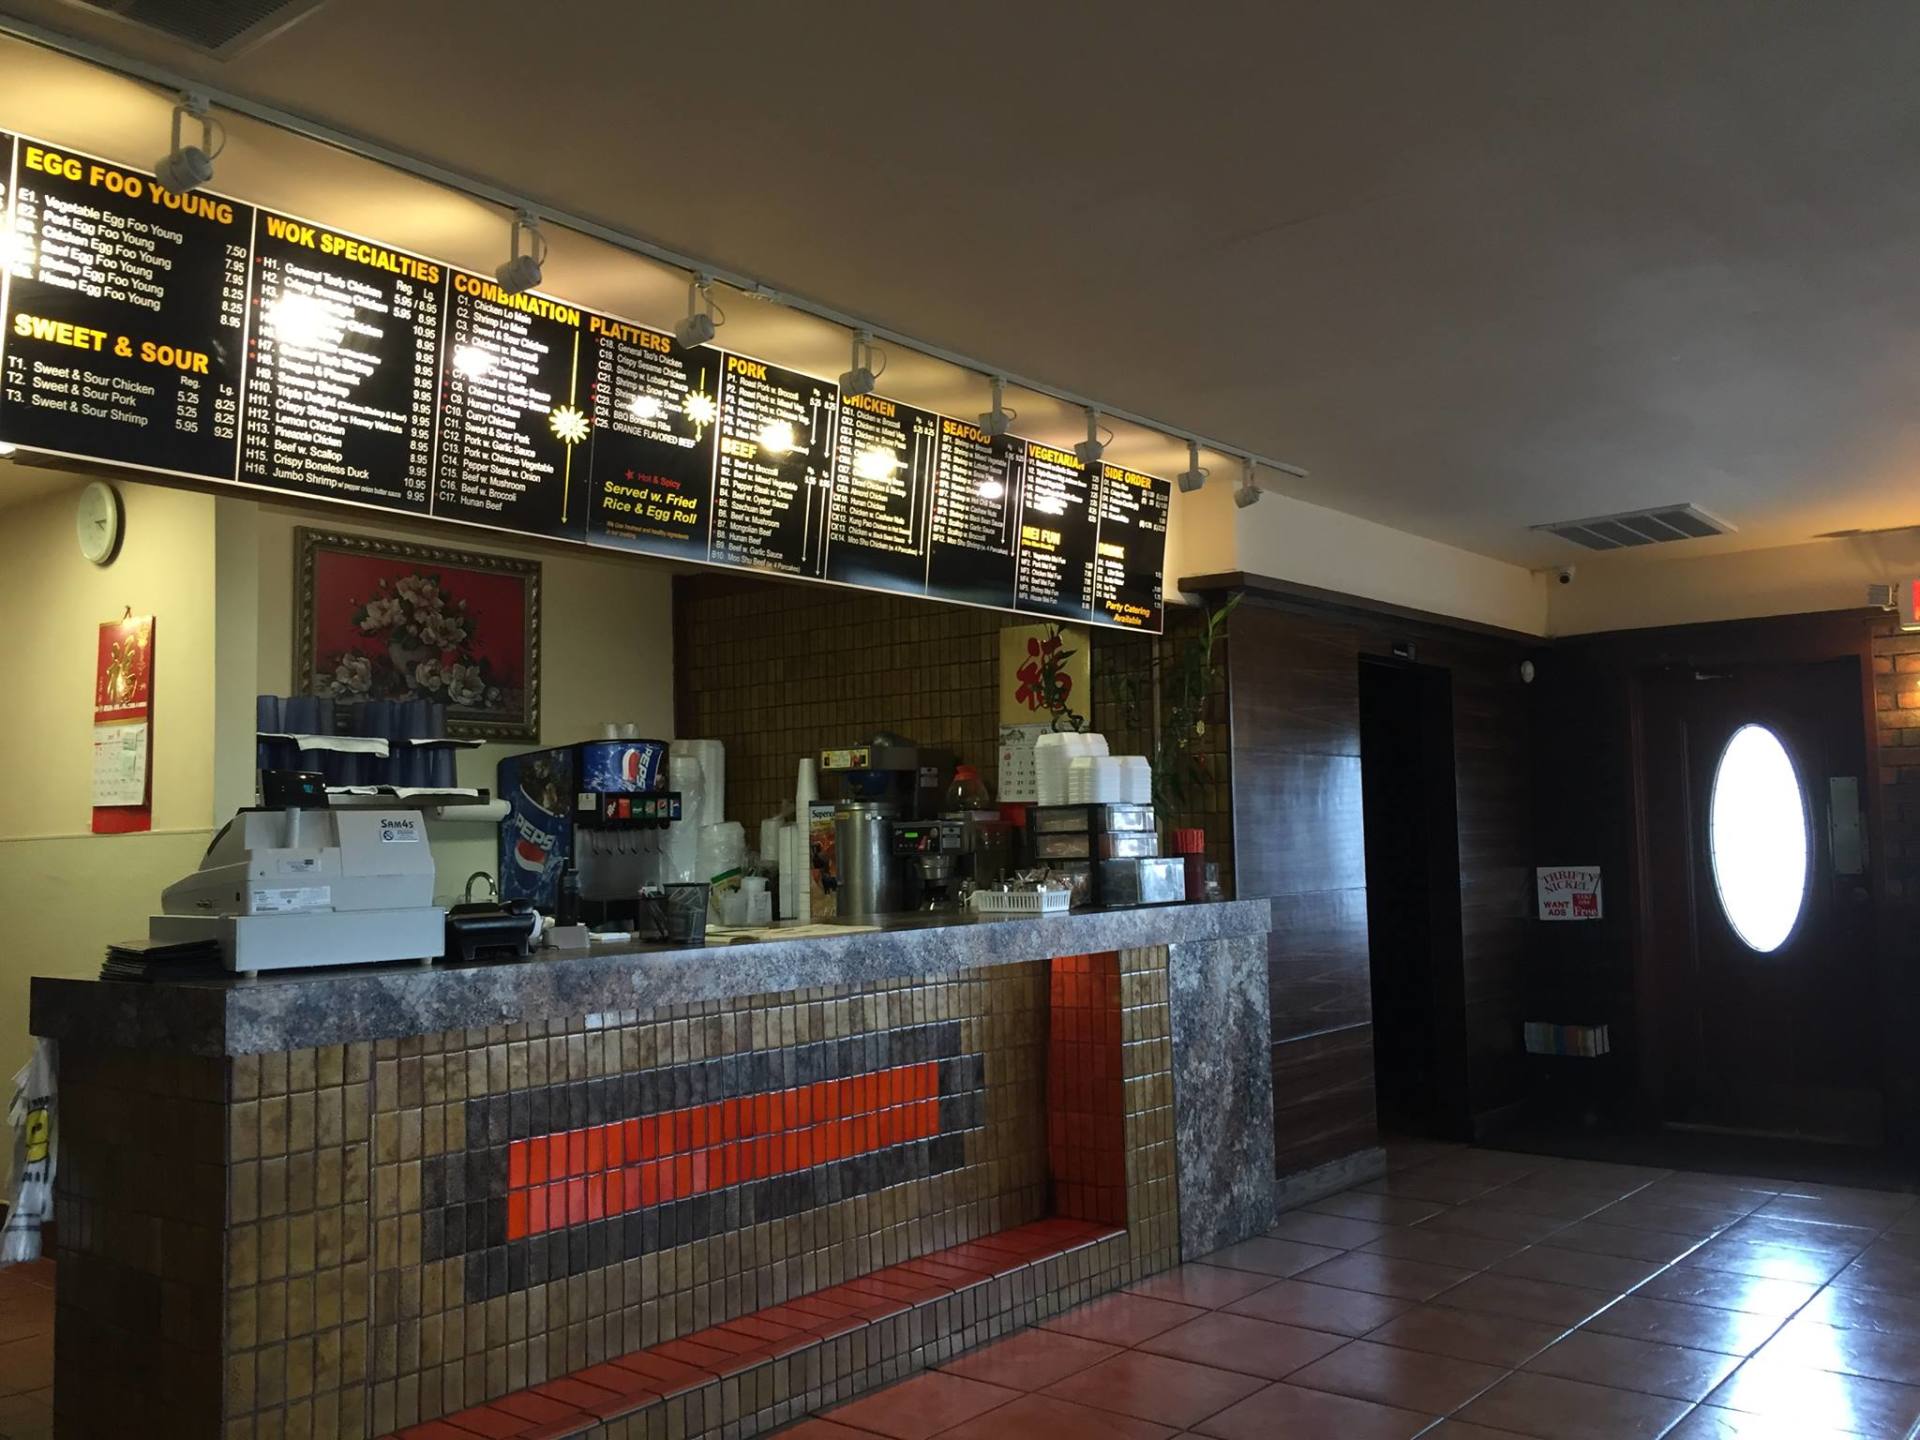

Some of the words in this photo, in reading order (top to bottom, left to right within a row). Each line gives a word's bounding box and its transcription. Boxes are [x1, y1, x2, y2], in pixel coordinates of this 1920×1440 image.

[26, 147, 82, 180] EGG
[90, 166, 142, 198] FOO
[150, 183, 234, 224] YOUNG
[19, 188, 39, 203] E1.
[45, 195, 100, 219] Vegetable
[103, 212, 125, 228] Egg
[127, 219, 148, 233] Foo
[151, 224, 183, 244] Young
[226, 245, 247, 258] 7.50
[43, 210, 71, 227] Pork
[73, 218, 95, 235] Egg
[98, 225, 119, 239] Foo
[122, 231, 155, 250] Young
[225, 259, 244, 272] 7.95
[267, 216, 316, 248] WOK
[320, 234, 440, 284] SPECIALTIES
[42, 226, 88, 246] Chicken
[91, 238, 113, 255] Egg
[116, 244, 136, 259] Foo
[139, 250, 171, 270] Young
[225, 272, 243, 285] 7.95
[70, 248, 93, 265] Egg
[96, 255, 117, 269] Foo
[120, 260, 153, 279] Young
[223, 287, 244, 300] 8.25
[263, 257, 280, 271] H1.
[394, 295, 412, 307] 5.95
[419, 300, 437, 314] 8.95
[83, 267, 105, 283] Egg
[107, 273, 129, 287] Foo
[132, 278, 164, 298] Young
[222, 301, 243, 314] 8.25
[454, 274, 580, 327] COMBINATION
[79, 281, 101, 297] Egg
[104, 286, 125, 300] Foo
[128, 293, 160, 311] Young
[220, 315, 240, 328] 8.95
[393, 308, 411, 319] 5.95
[418, 313, 436, 326] 8.95
[458, 295, 470, 306] C1.
[474, 300, 503, 316] Chicken
[504, 309, 513, 319] Lo
[413, 325, 435, 338] 10.95
[473, 312, 498, 328] Shrimp
[500, 320, 509, 330] Lo
[14, 314, 107, 351] SWEET
[114, 336, 133, 357] &
[141, 342, 209, 374] SOUR
[416, 339, 435, 351] 8.95
[590, 316, 671, 353] PLATTERS
[415, 352, 434, 364] 9.95
[728, 356, 767, 380] PORK
[8, 356, 26, 370] T1.
[34, 361, 69, 379] Sweet
[72, 369, 80, 380] &
[84, 372, 109, 386] Sour
[112, 377, 154, 395] Chicken
[177, 391, 199, 404] 5.25
[215, 399, 235, 411] 8.25
[181, 376, 200, 389] Reg.
[220, 384, 234, 396] Lg.
[413, 390, 431, 402] 9.95
[414, 378, 432, 389] 9.95
[7, 371, 25, 385] T2.
[32, 377, 68, 394] Sweet
[71, 384, 79, 395] &
[83, 387, 109, 401] Sour
[111, 392, 136, 406] Pork
[177, 405, 197, 418] 5.25
[214, 413, 235, 425] 8.25
[249, 380, 272, 393] H10.
[412, 415, 430, 426] 9.95
[413, 403, 431, 414] 9.95
[445, 404, 462, 417] C10.
[843, 394, 895, 417] CHICKEN
[6, 389, 24, 403] T3.
[32, 394, 67, 411] Sweet
[70, 402, 78, 412] &
[81, 404, 107, 418] Sour
[111, 409, 148, 427] Shrimp
[176, 420, 198, 433] 5.95
[214, 427, 234, 439] 9.25
[249, 393, 270, 407] H11.
[275, 399, 305, 415] Crispy
[307, 404, 339, 422] Shrimp
[411, 428, 429, 440] 9.95
[444, 417, 461, 430] C11.
[248, 407, 270, 421] H12.
[276, 413, 307, 428] Lemon
[309, 419, 345, 435] Chicken
[410, 441, 428, 452] 8.95
[464, 434, 482, 446] Pork
[943, 421, 991, 444] SEAFOOD
[247, 421, 270, 434] H13.
[313, 431, 342, 447] Chicken
[410, 453, 427, 465] 8.95
[442, 442, 460, 454] C13.
[464, 446, 480, 458] Pork
[721, 437, 757, 459] BEEF
[246, 448, 268, 461] H15.
[274, 454, 303, 468] Crispy
[305, 458, 345, 475] Boneless
[347, 466, 369, 479] Duck
[404, 478, 426, 489] 10.95
[247, 435, 269, 448] H14.
[274, 440, 295, 452] Beef
[297, 445, 308, 454] w.
[310, 447, 342, 462] Scallop
[409, 466, 427, 477] 9.95
[442, 454, 459, 466] C14.
[463, 459, 489, 472] Pepper
[490, 464, 510, 477] Steak
[520, 470, 541, 482] Onion
[245, 462, 267, 475] H16.
[273, 468, 303, 481] Jumbo
[306, 473, 337, 488] Shrimp
[407, 491, 424, 501] 9.95
[441, 467, 458, 478] C15.
[462, 471, 480, 482] Beef
[490, 477, 526, 491] Mushroom
[661, 479, 681, 489] Spicy
[1104, 467, 1123, 481] SIDE
[1125, 473, 1151, 489] ORDER
[440, 492, 456, 502] C17.
[604, 481, 648, 499] Served
[651, 493, 662, 502] w.
[666, 493, 697, 509] Fried
[603, 497, 631, 512] Rice
[634, 503, 643, 514] &
[646, 506, 670, 521] Egg
[673, 511, 697, 524] Roll
[1022, 526, 1040, 539] MEI
[1041, 530, 1061, 545] FUN
[1106, 601, 1123, 612] Party
[1124, 604, 1150, 618] Catering
[1114, 613, 1141, 625] Available
